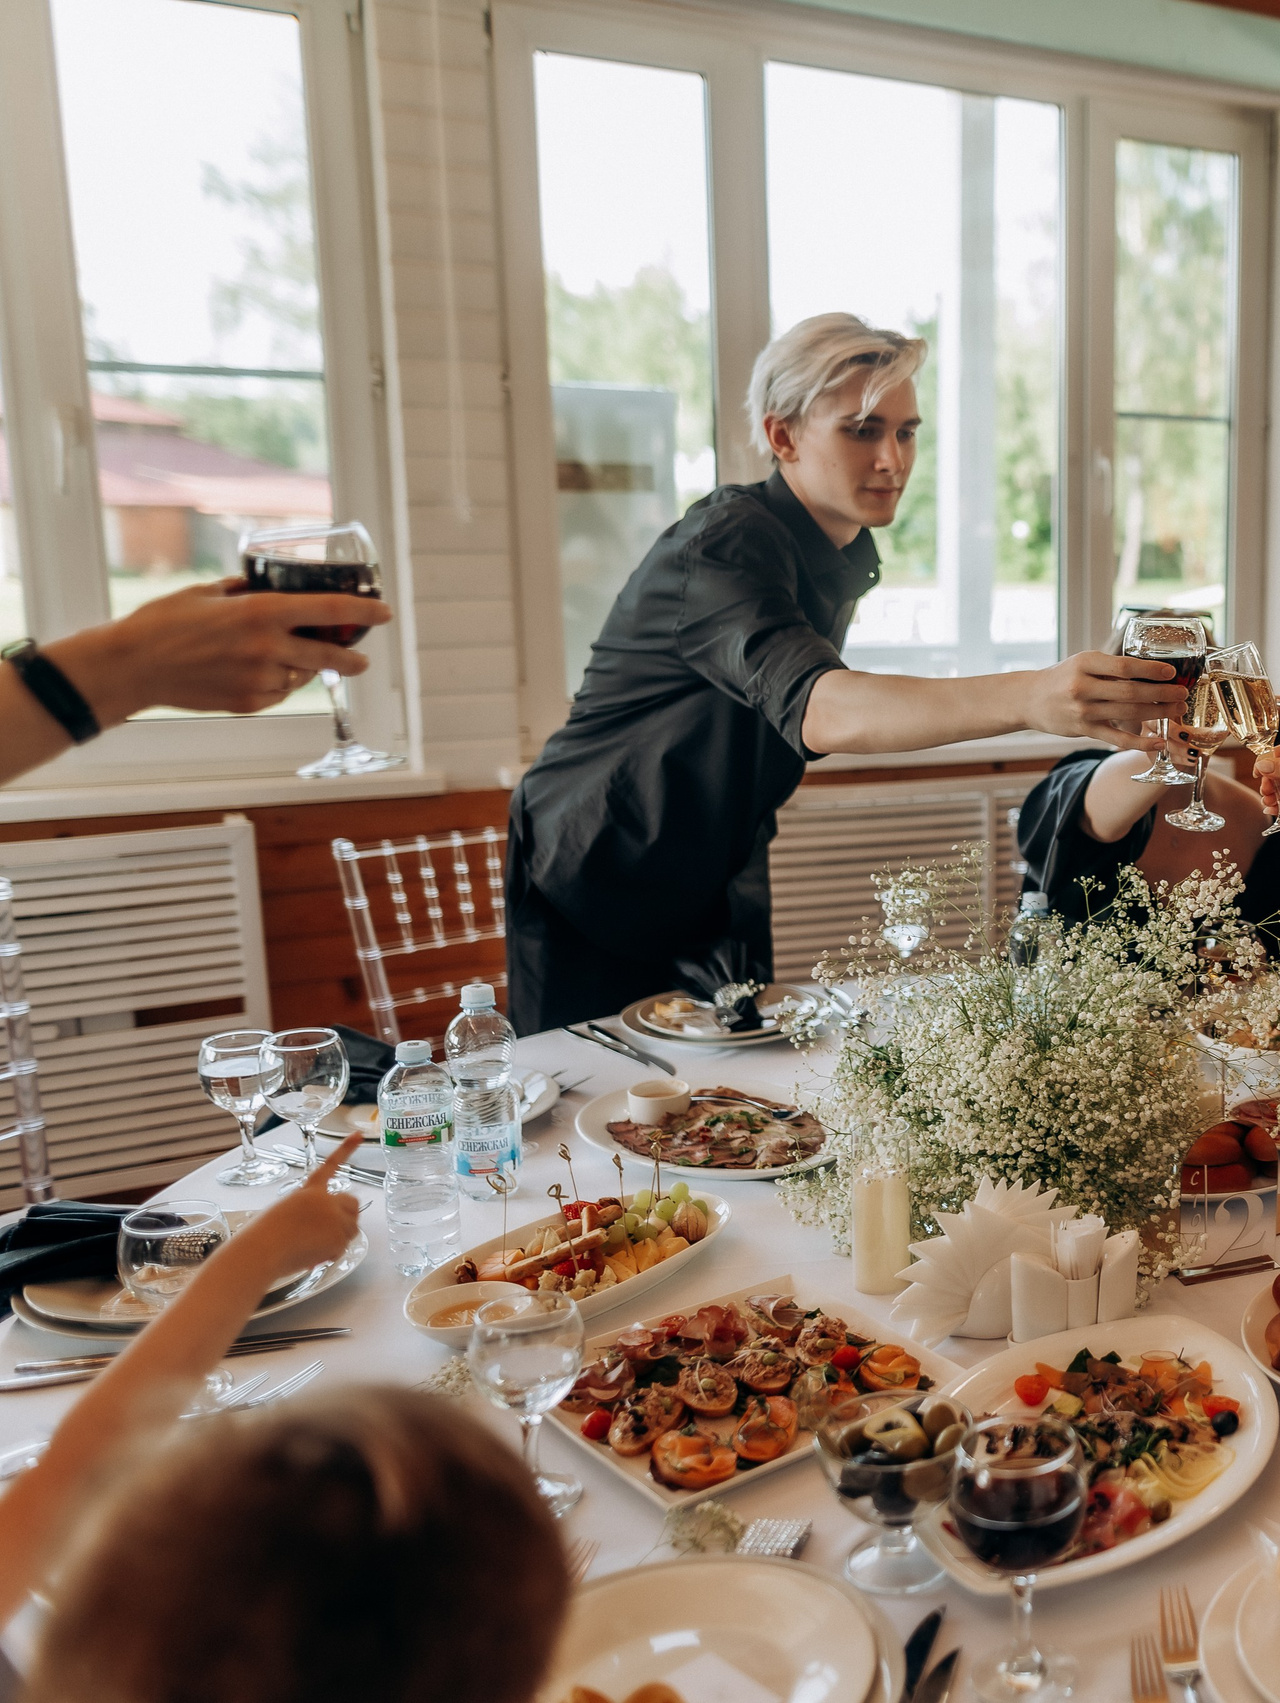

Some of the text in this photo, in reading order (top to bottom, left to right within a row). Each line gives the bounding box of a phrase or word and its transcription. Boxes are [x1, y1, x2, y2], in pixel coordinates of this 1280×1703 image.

[386, 1112, 446, 1129] СЕНЕЖСКАЯ
[458, 1137, 509, 1152] СЕНЕЖСКАЯ
[1214, 1191, 1267, 1266] 2
